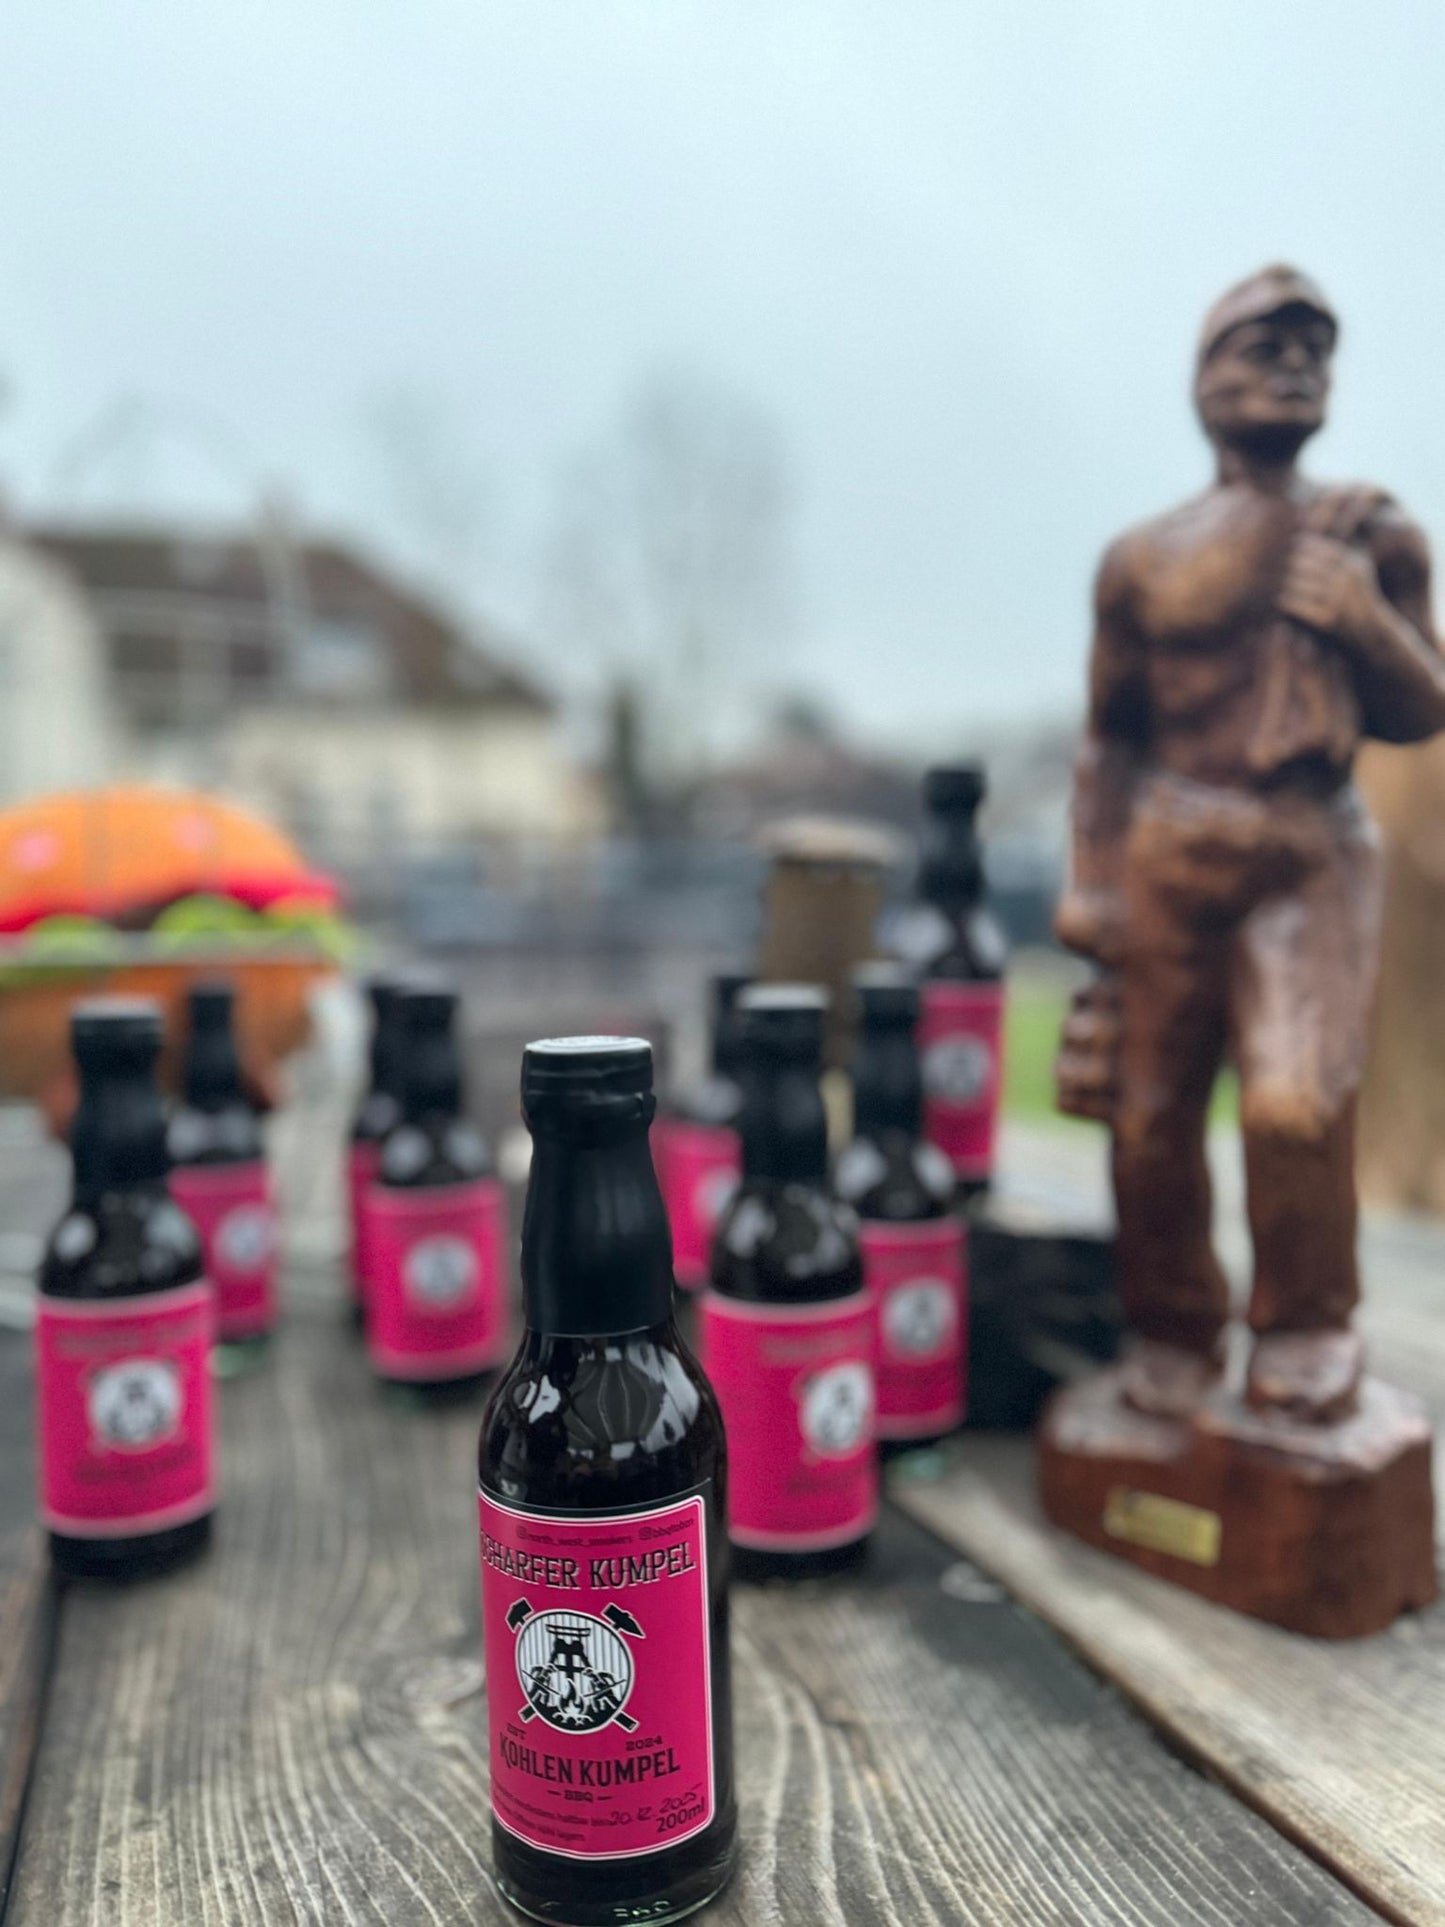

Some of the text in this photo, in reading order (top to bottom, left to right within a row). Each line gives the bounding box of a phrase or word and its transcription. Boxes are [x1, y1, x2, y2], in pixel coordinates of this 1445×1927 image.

[589, 1541, 697, 1591] KUMPEL
[499, 1731, 681, 1787] KOHLEN KUMPEL
[625, 1735, 663, 1752] 2024
[564, 1789, 594, 1803] BBQ
[656, 1795, 705, 1833] 200ml
